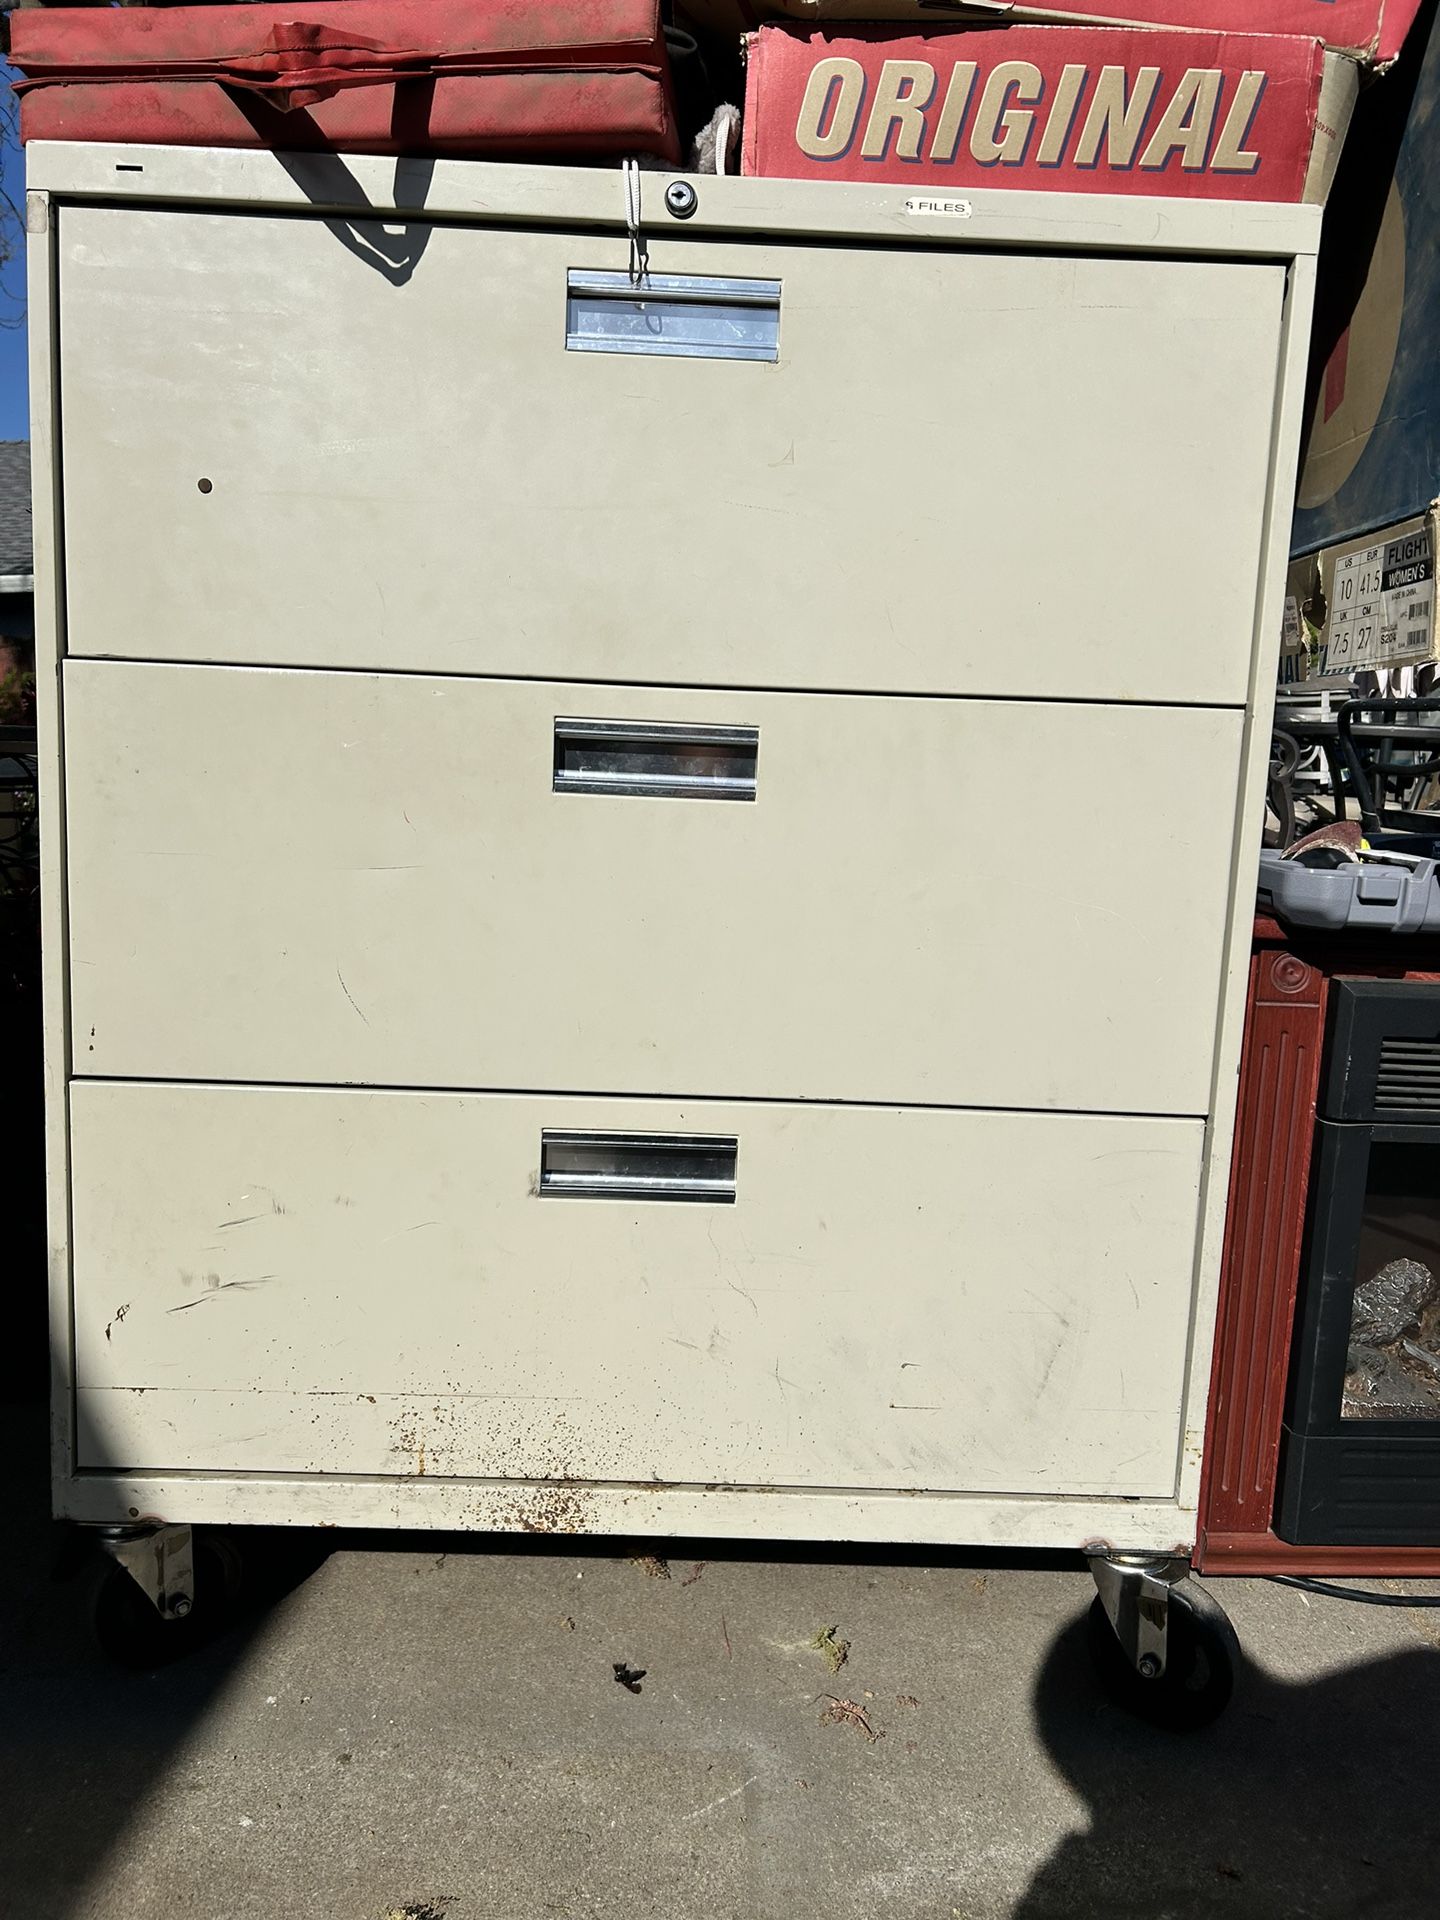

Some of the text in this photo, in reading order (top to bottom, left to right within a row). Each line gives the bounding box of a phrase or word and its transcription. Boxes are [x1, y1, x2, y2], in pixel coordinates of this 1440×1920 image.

[795, 56, 1266, 175] ORIGINAL
[918, 202, 966, 213] FILES
[1344, 557, 1353, 568] US
[1366, 549, 1378, 561] EUR
[1388, 538, 1427, 565] FLIGHT
[1359, 569, 1380, 596] 41.5
[1389, 563, 1425, 587] WOMEN'S
[1340, 577, 1353, 601] 10
[1339, 611, 1347, 621] UK
[1362, 605, 1372, 616] CM
[1332, 631, 1349, 655] 7.5
[1357, 626, 1372, 650] 27
